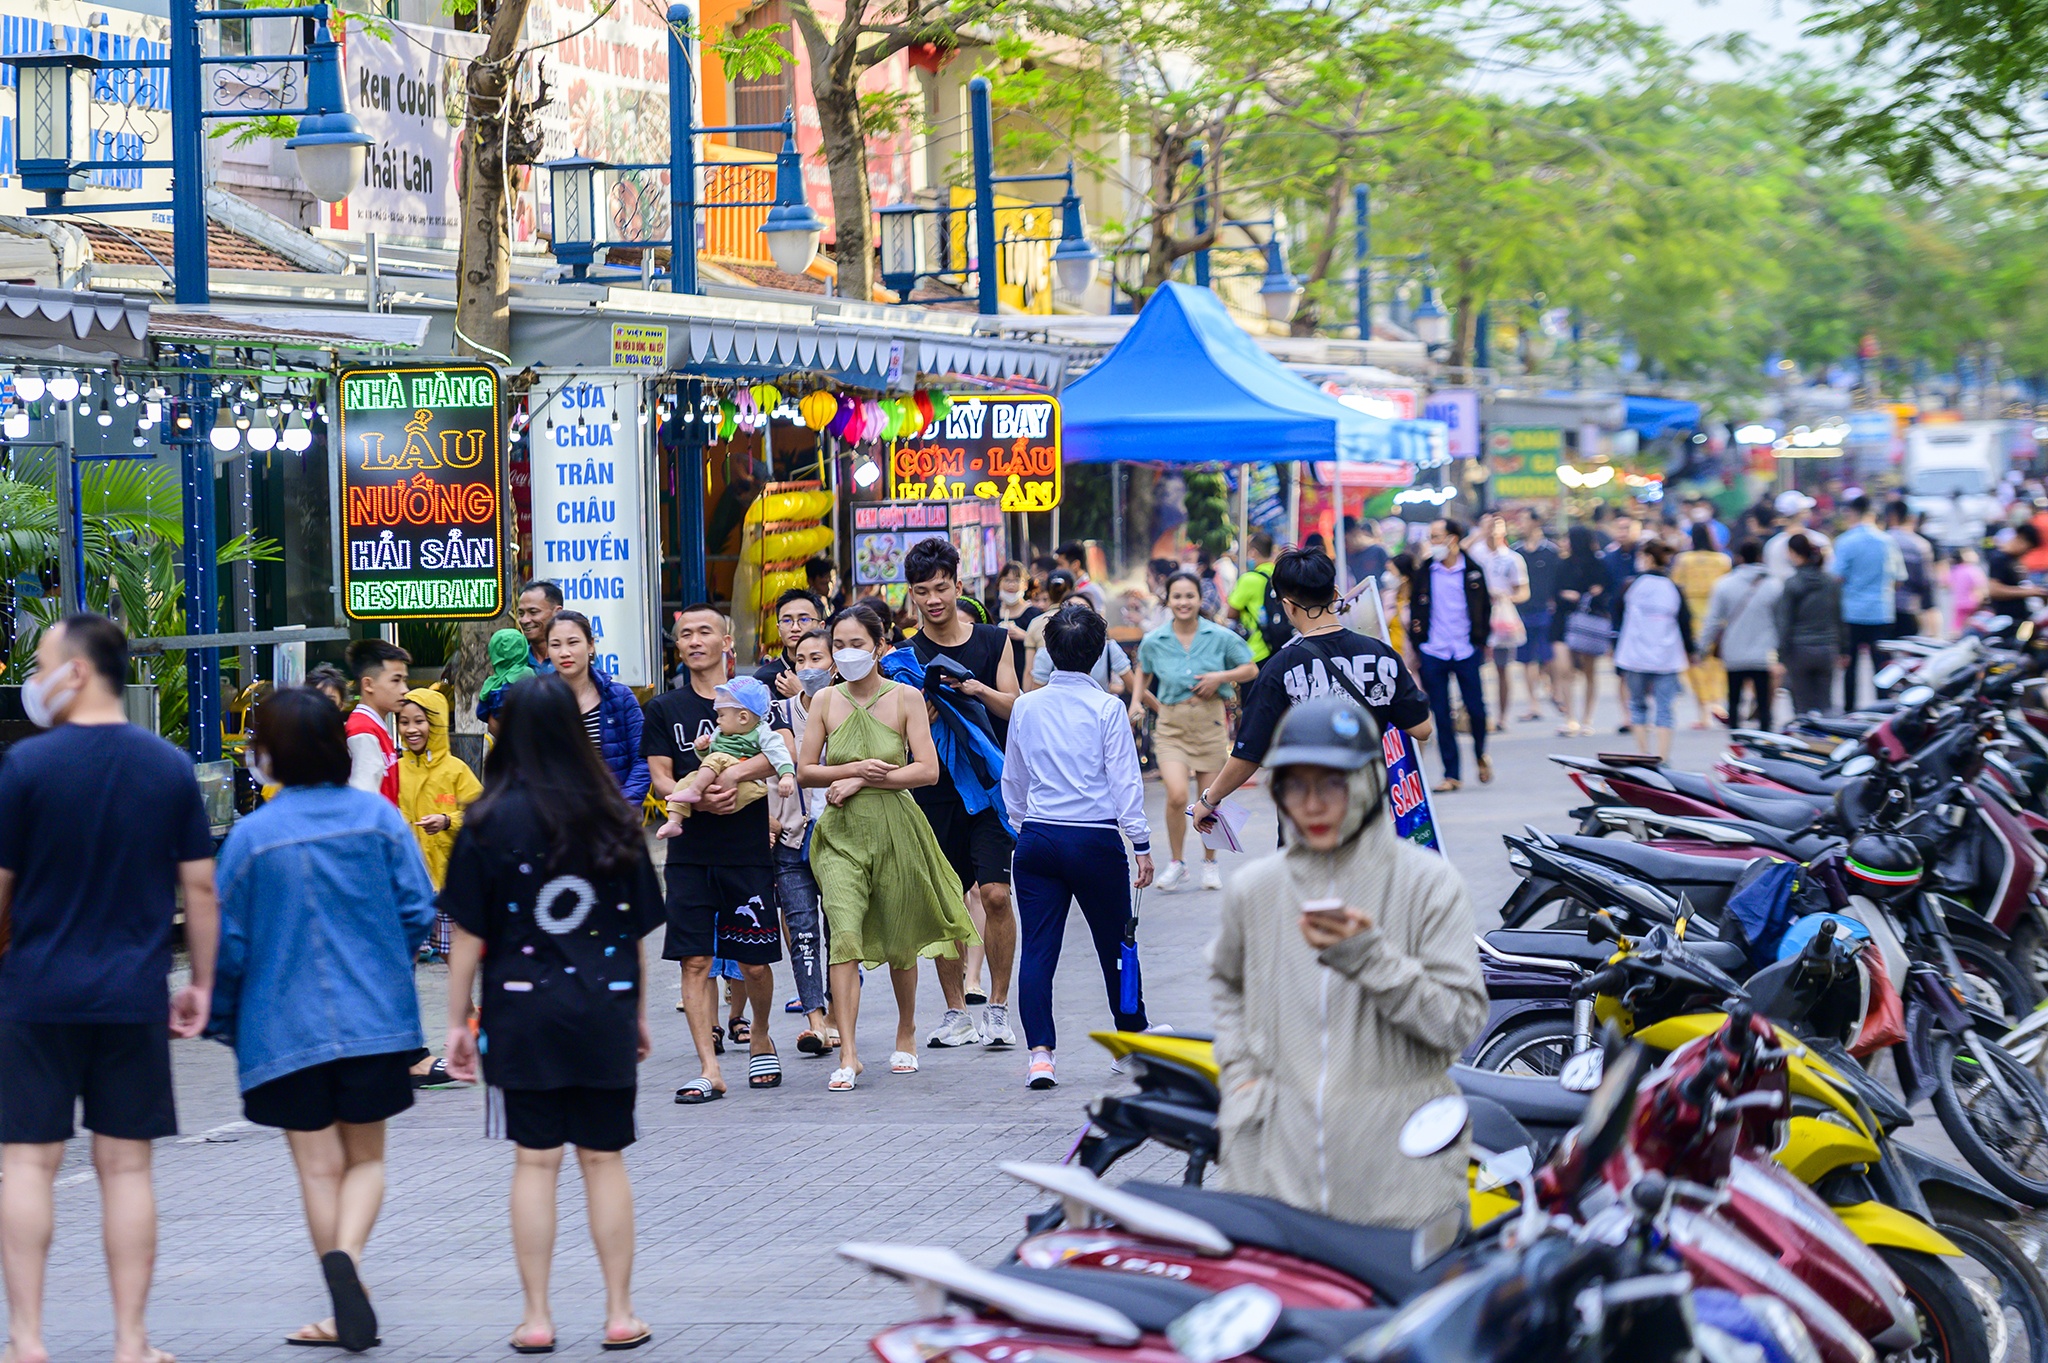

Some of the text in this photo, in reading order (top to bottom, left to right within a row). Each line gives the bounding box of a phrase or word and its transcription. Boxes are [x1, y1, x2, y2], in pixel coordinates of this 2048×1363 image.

[643, 39, 668, 84] SỐN
[360, 66, 437, 127] Kem Cuộn
[363, 140, 433, 194] Thái Lan
[344, 370, 494, 410] NHÀ HÀNG
[561, 381, 606, 409] SỮA
[359, 408, 487, 470] LẨU
[555, 424, 614, 448] CHUA
[991, 403, 1052, 440] BAY
[555, 457, 614, 486] TRÂN
[894, 443, 966, 477] CƠM
[987, 436, 1056, 477] LẨU
[349, 471, 495, 526] NƯỚNG
[556, 495, 616, 524] CHÂU
[856, 507, 878, 530] KEM
[905, 502, 927, 529] THÁI
[927, 504, 948, 528] LAN
[351, 528, 494, 570] HẢI SẢN
[544, 531, 629, 562] TRUYỀN
[349, 579, 498, 611] RESTAURANT
[1391, 768, 1425, 817] SẢN
